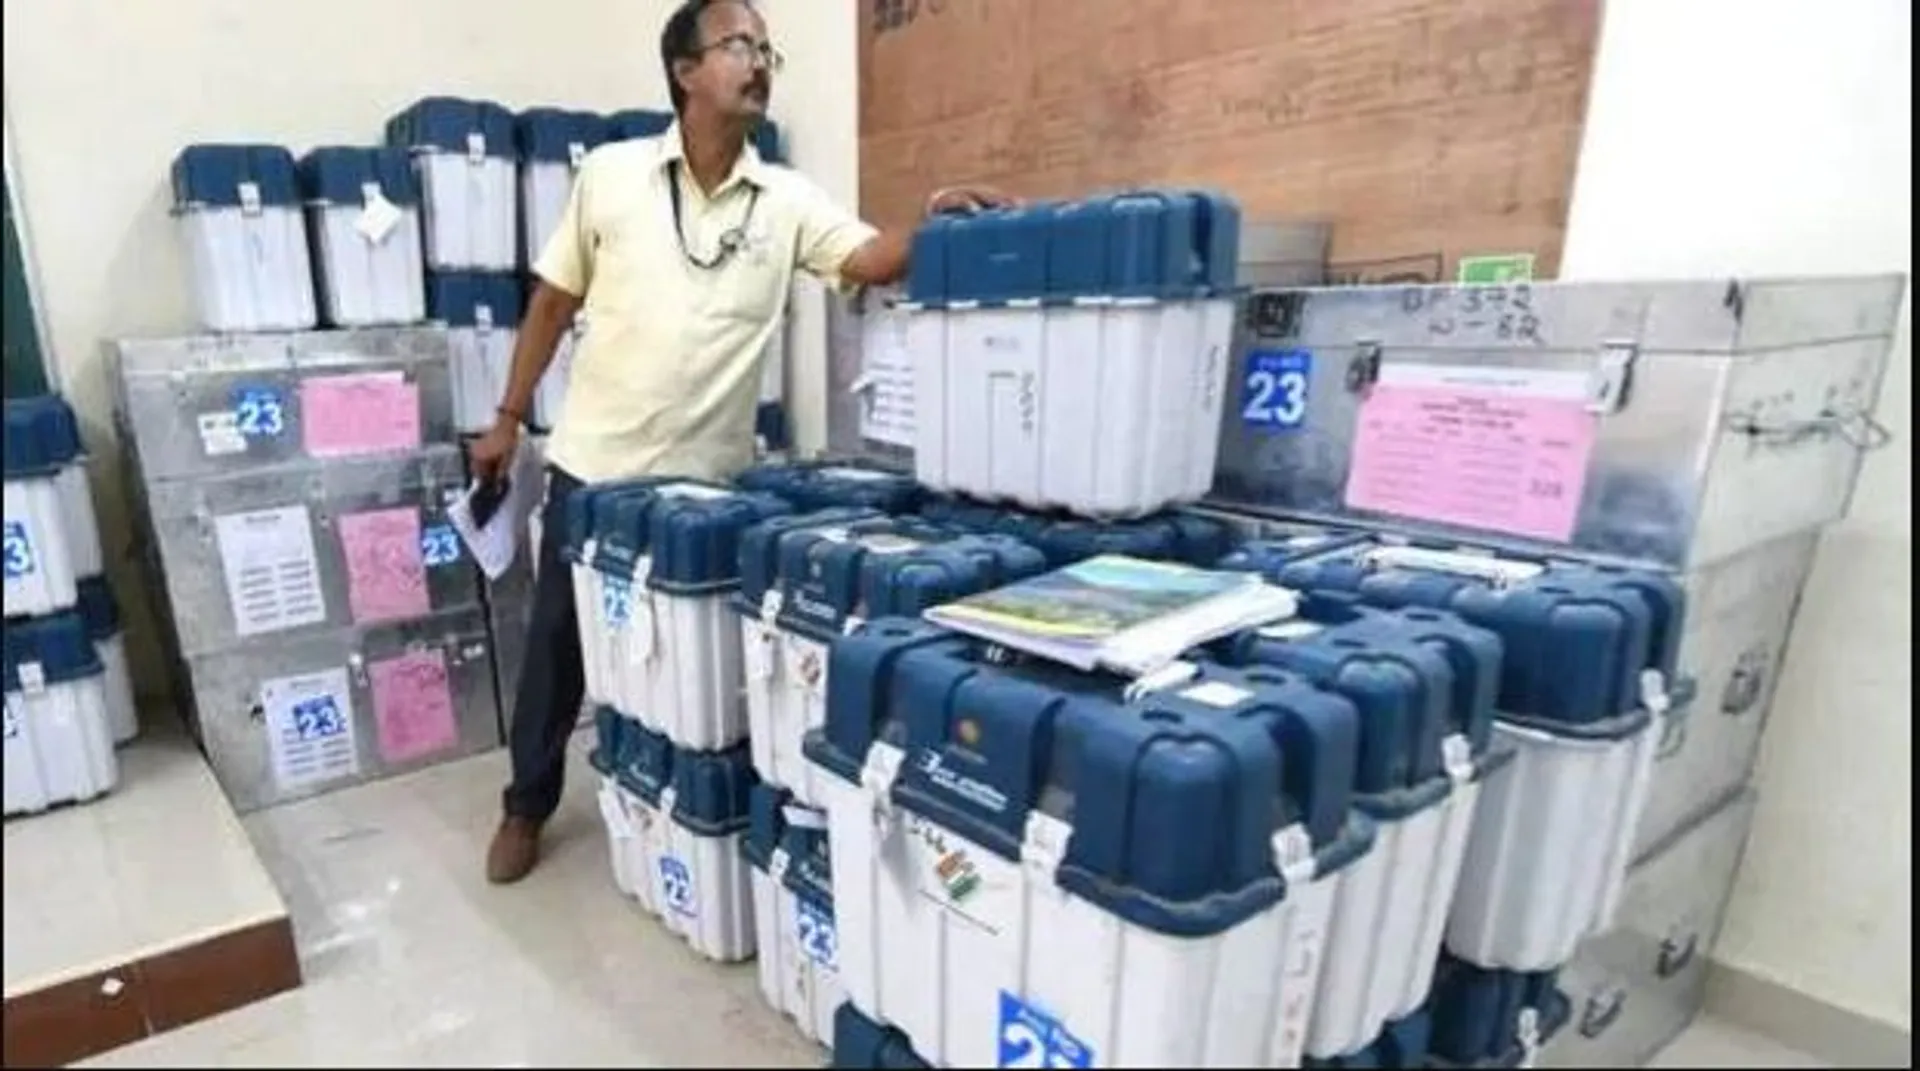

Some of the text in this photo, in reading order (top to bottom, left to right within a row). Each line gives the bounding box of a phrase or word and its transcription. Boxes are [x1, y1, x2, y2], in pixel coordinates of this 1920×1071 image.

[1243, 371, 1306, 423] 23
[240, 402, 283, 435] 23
[422, 533, 459, 566] 23
[299, 706, 338, 739] 23
[1003, 1022, 1072, 1068] 2
